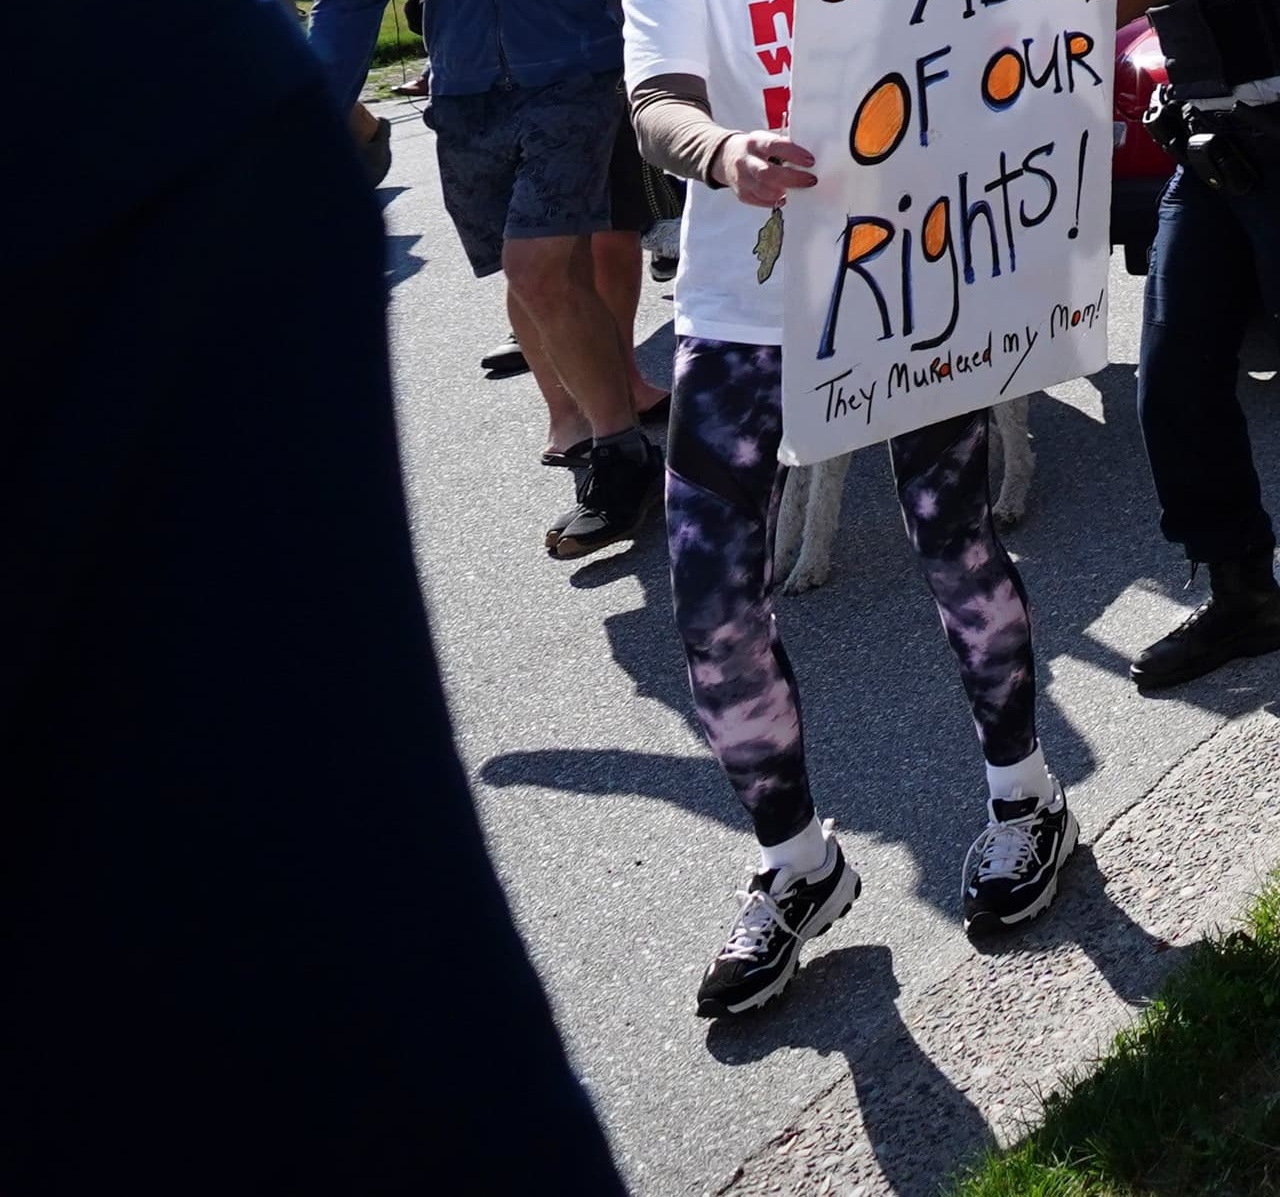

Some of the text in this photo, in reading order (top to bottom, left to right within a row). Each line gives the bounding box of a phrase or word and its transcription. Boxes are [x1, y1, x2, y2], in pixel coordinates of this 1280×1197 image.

[849, 45, 952, 167] OF
[981, 30, 1103, 113] OUR
[812, 366, 877, 425] They
